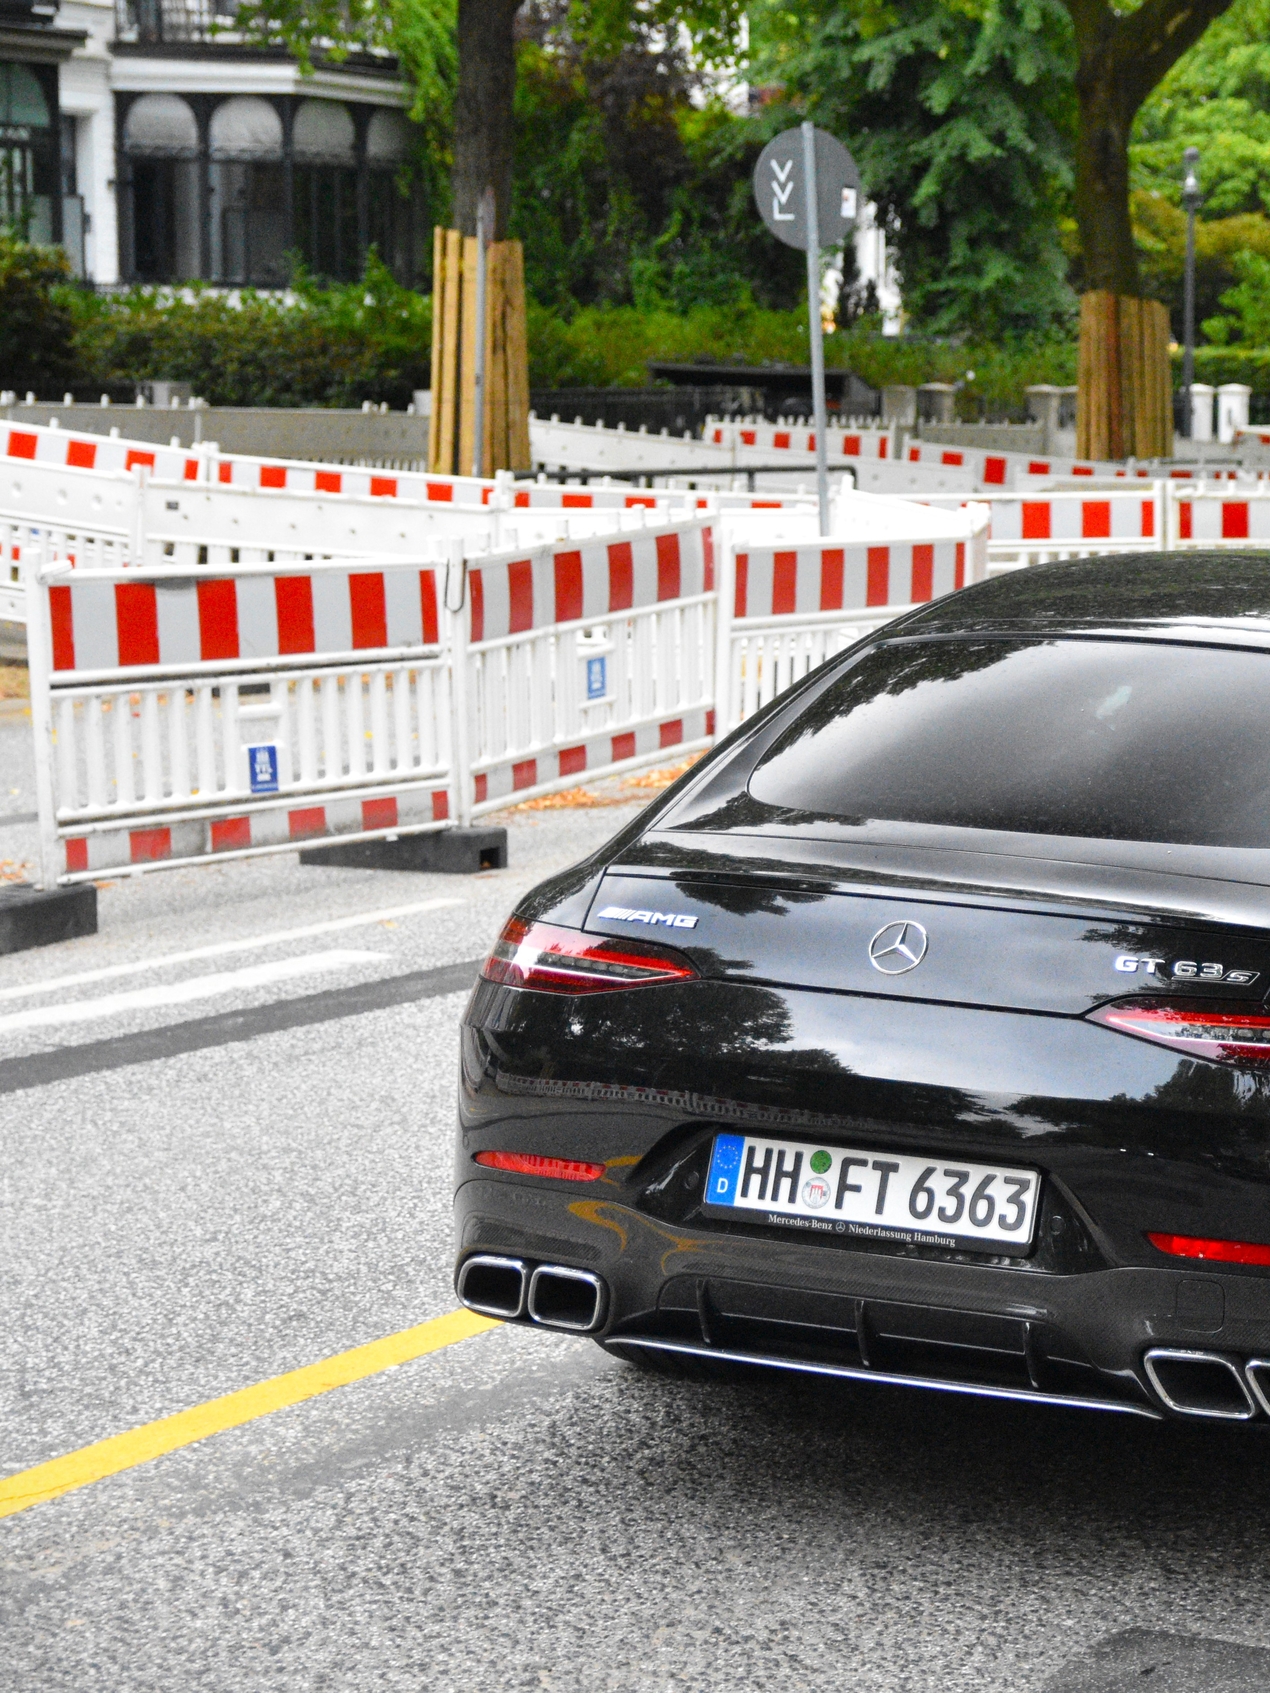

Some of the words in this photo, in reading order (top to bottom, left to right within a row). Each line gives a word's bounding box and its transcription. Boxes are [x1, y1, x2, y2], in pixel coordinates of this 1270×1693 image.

[627, 909, 700, 930] AMG
[1114, 955, 1166, 975] GT
[1173, 960, 1224, 979] 63
[716, 1177, 729, 1194] D
[740, 1145, 804, 1204] HH
[834, 1156, 900, 1215] FT
[908, 1165, 1031, 1232] 6363
[768, 1213, 833, 1231] Mercedes-Benz
[848, 1223, 912, 1242] Niederlassung
[914, 1231, 956, 1247] Hamburg
